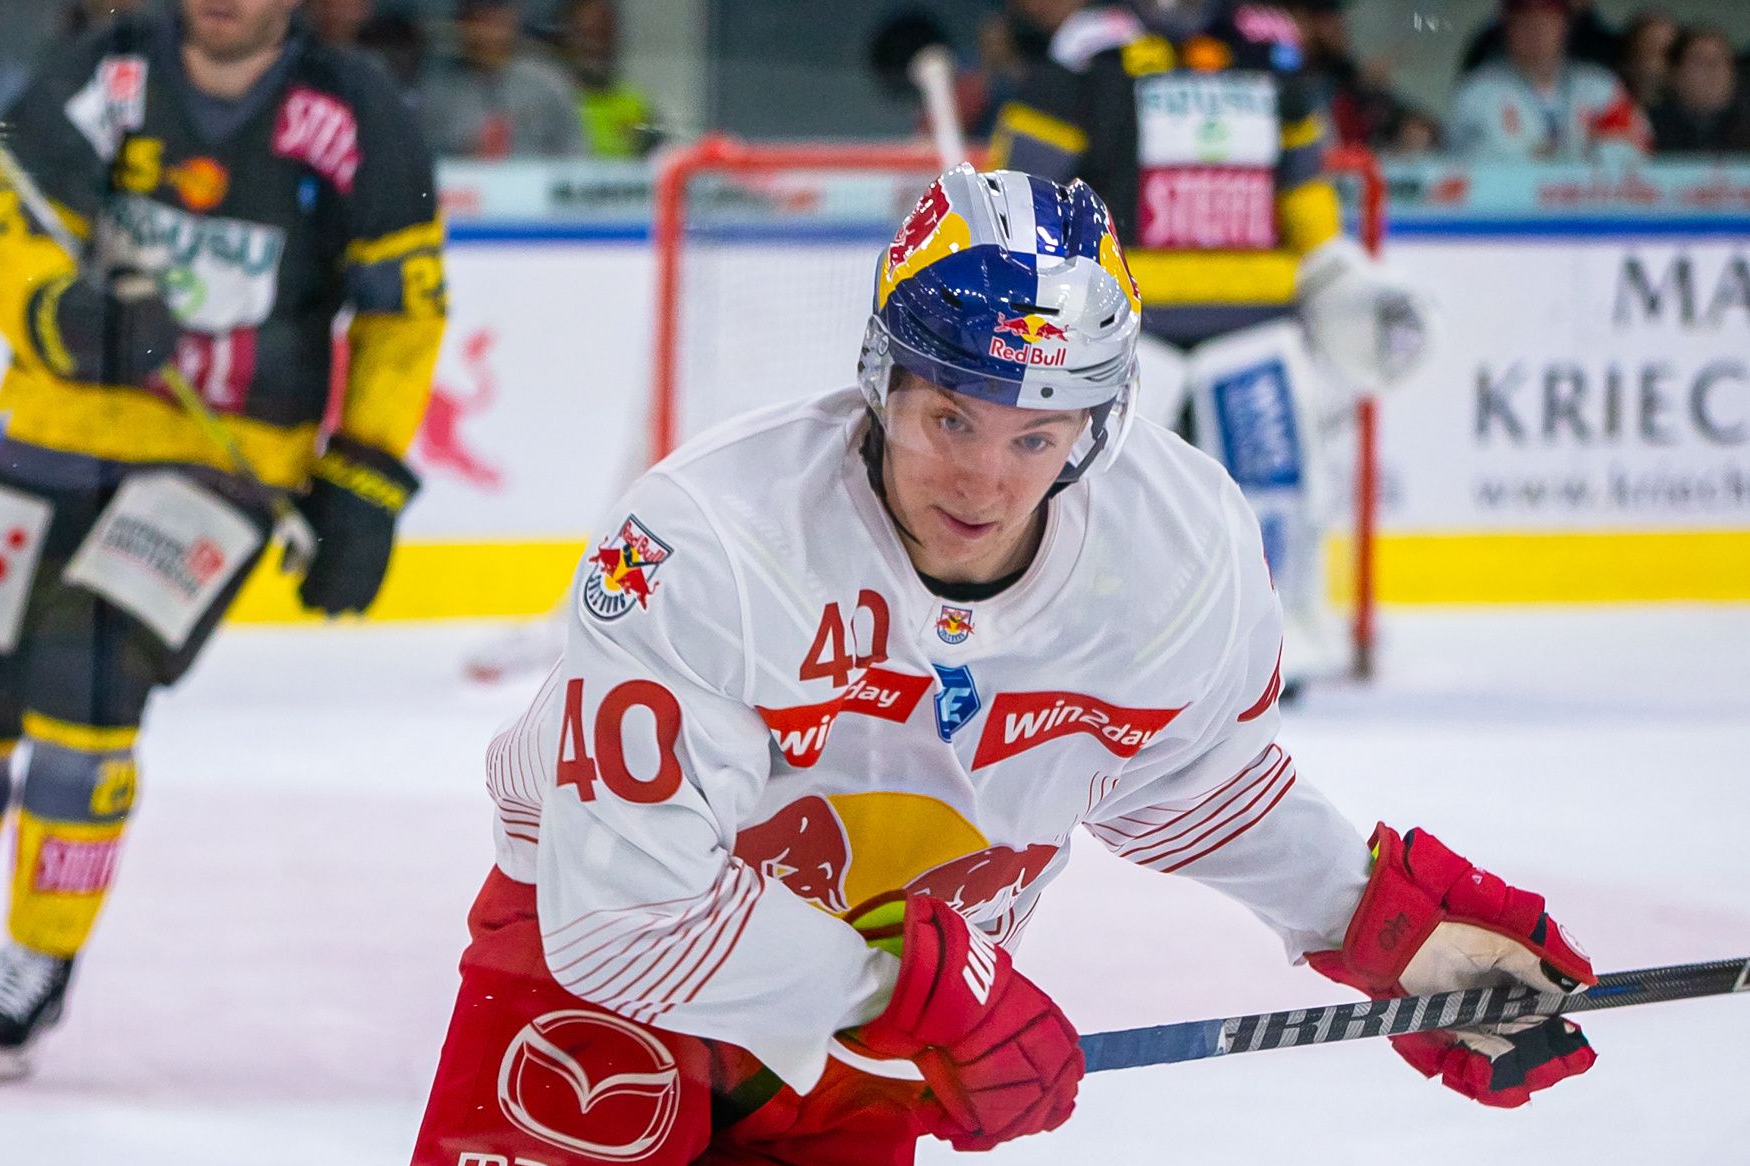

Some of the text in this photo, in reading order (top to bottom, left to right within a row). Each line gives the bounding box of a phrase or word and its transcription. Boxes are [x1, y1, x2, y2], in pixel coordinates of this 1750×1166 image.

[989, 338, 1066, 366] Red Bull
[1472, 361, 1750, 445] KRIEC
[799, 589, 890, 689] 40
[556, 677, 683, 804] 40
